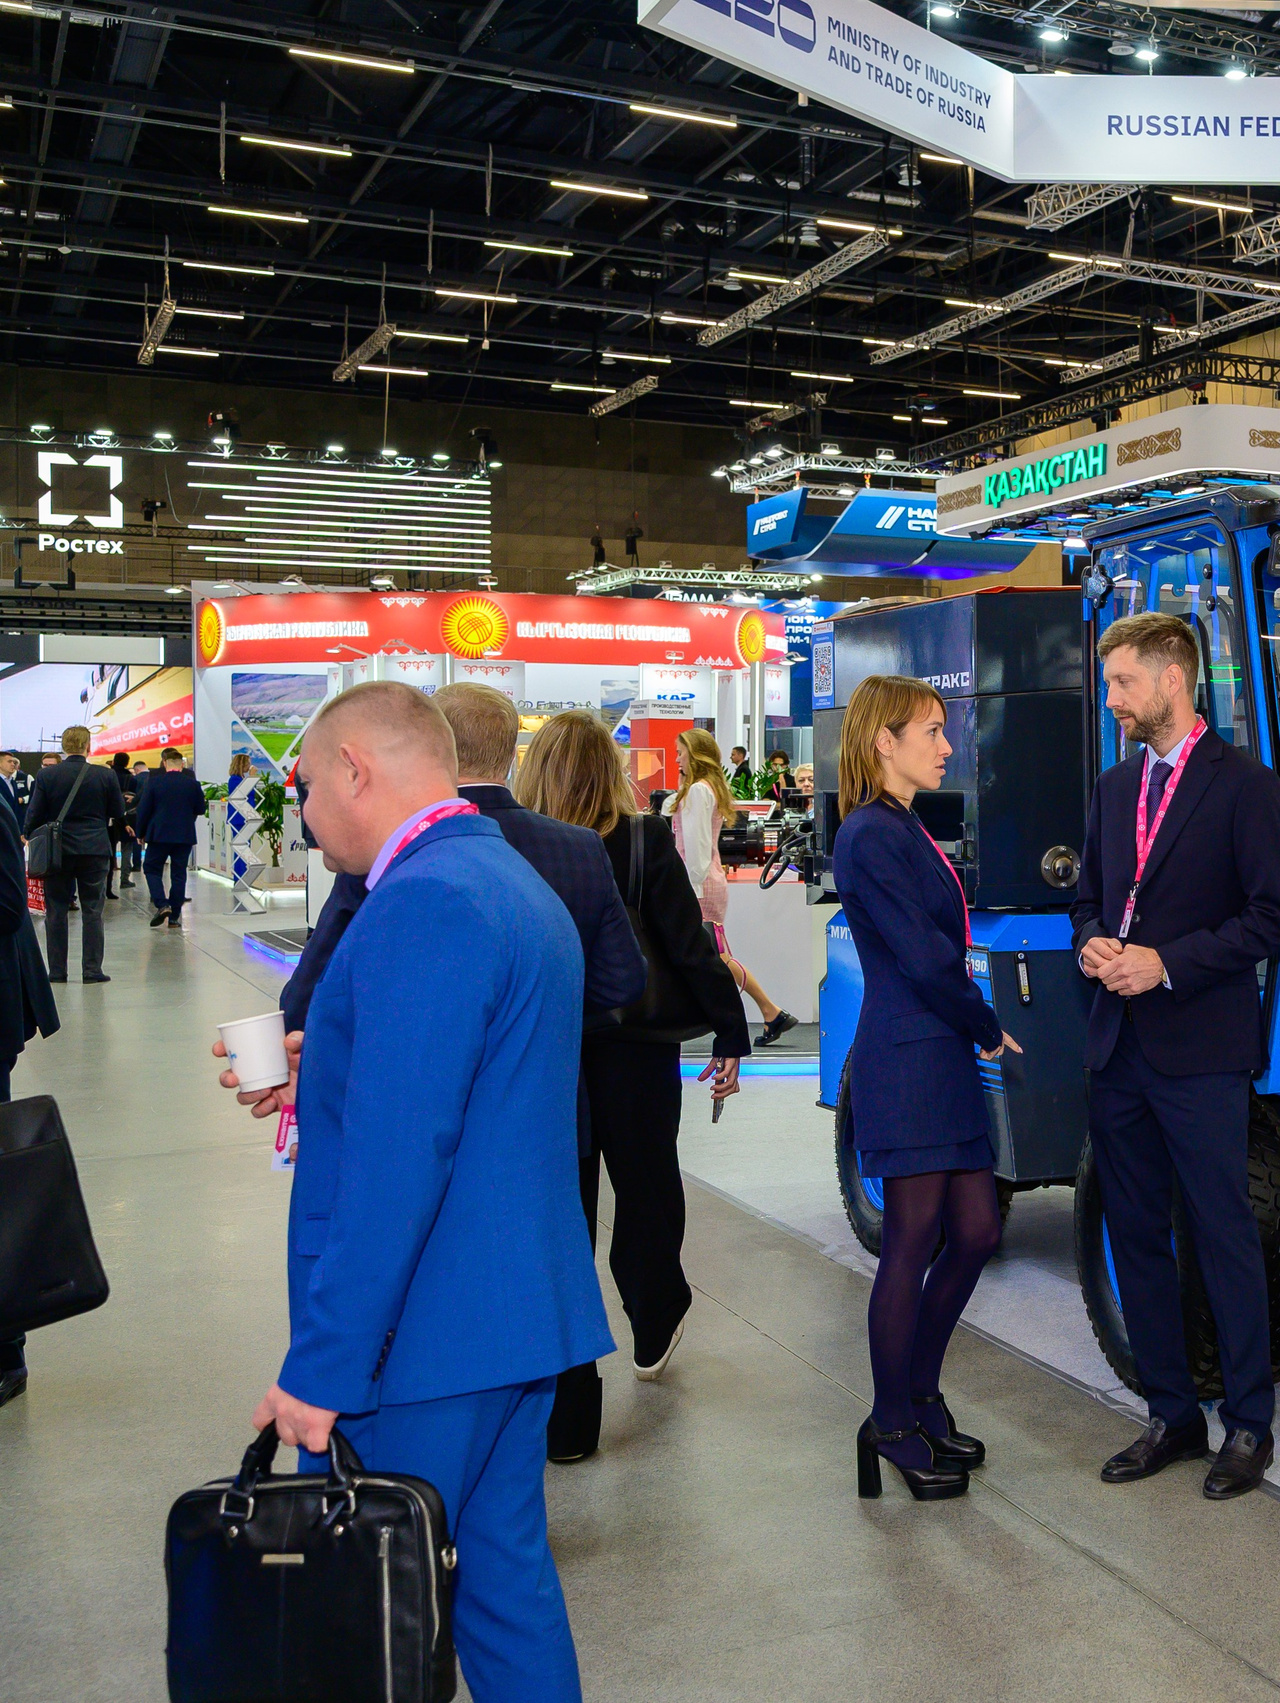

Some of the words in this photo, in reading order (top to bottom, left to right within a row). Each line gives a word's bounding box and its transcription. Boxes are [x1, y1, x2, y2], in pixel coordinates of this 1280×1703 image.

[828, 16, 899, 65] MINISTRY
[903, 54, 922, 76] OF
[925, 63, 991, 109] INDUSTRY
[828, 45, 862, 74] AND
[865, 61, 913, 99] TRADE
[916, 87, 935, 108] OF
[938, 96, 987, 133] RUSSIA
[1107, 114, 1230, 137] RUSSIAN
[985, 442, 1108, 509] ҚАЗАҚСТАН
[907, 506, 937, 520] НА
[907, 519, 937, 532] СТ
[38, 533, 124, 555] Ростех
[121, 721, 168, 742] СЛУЖБА
